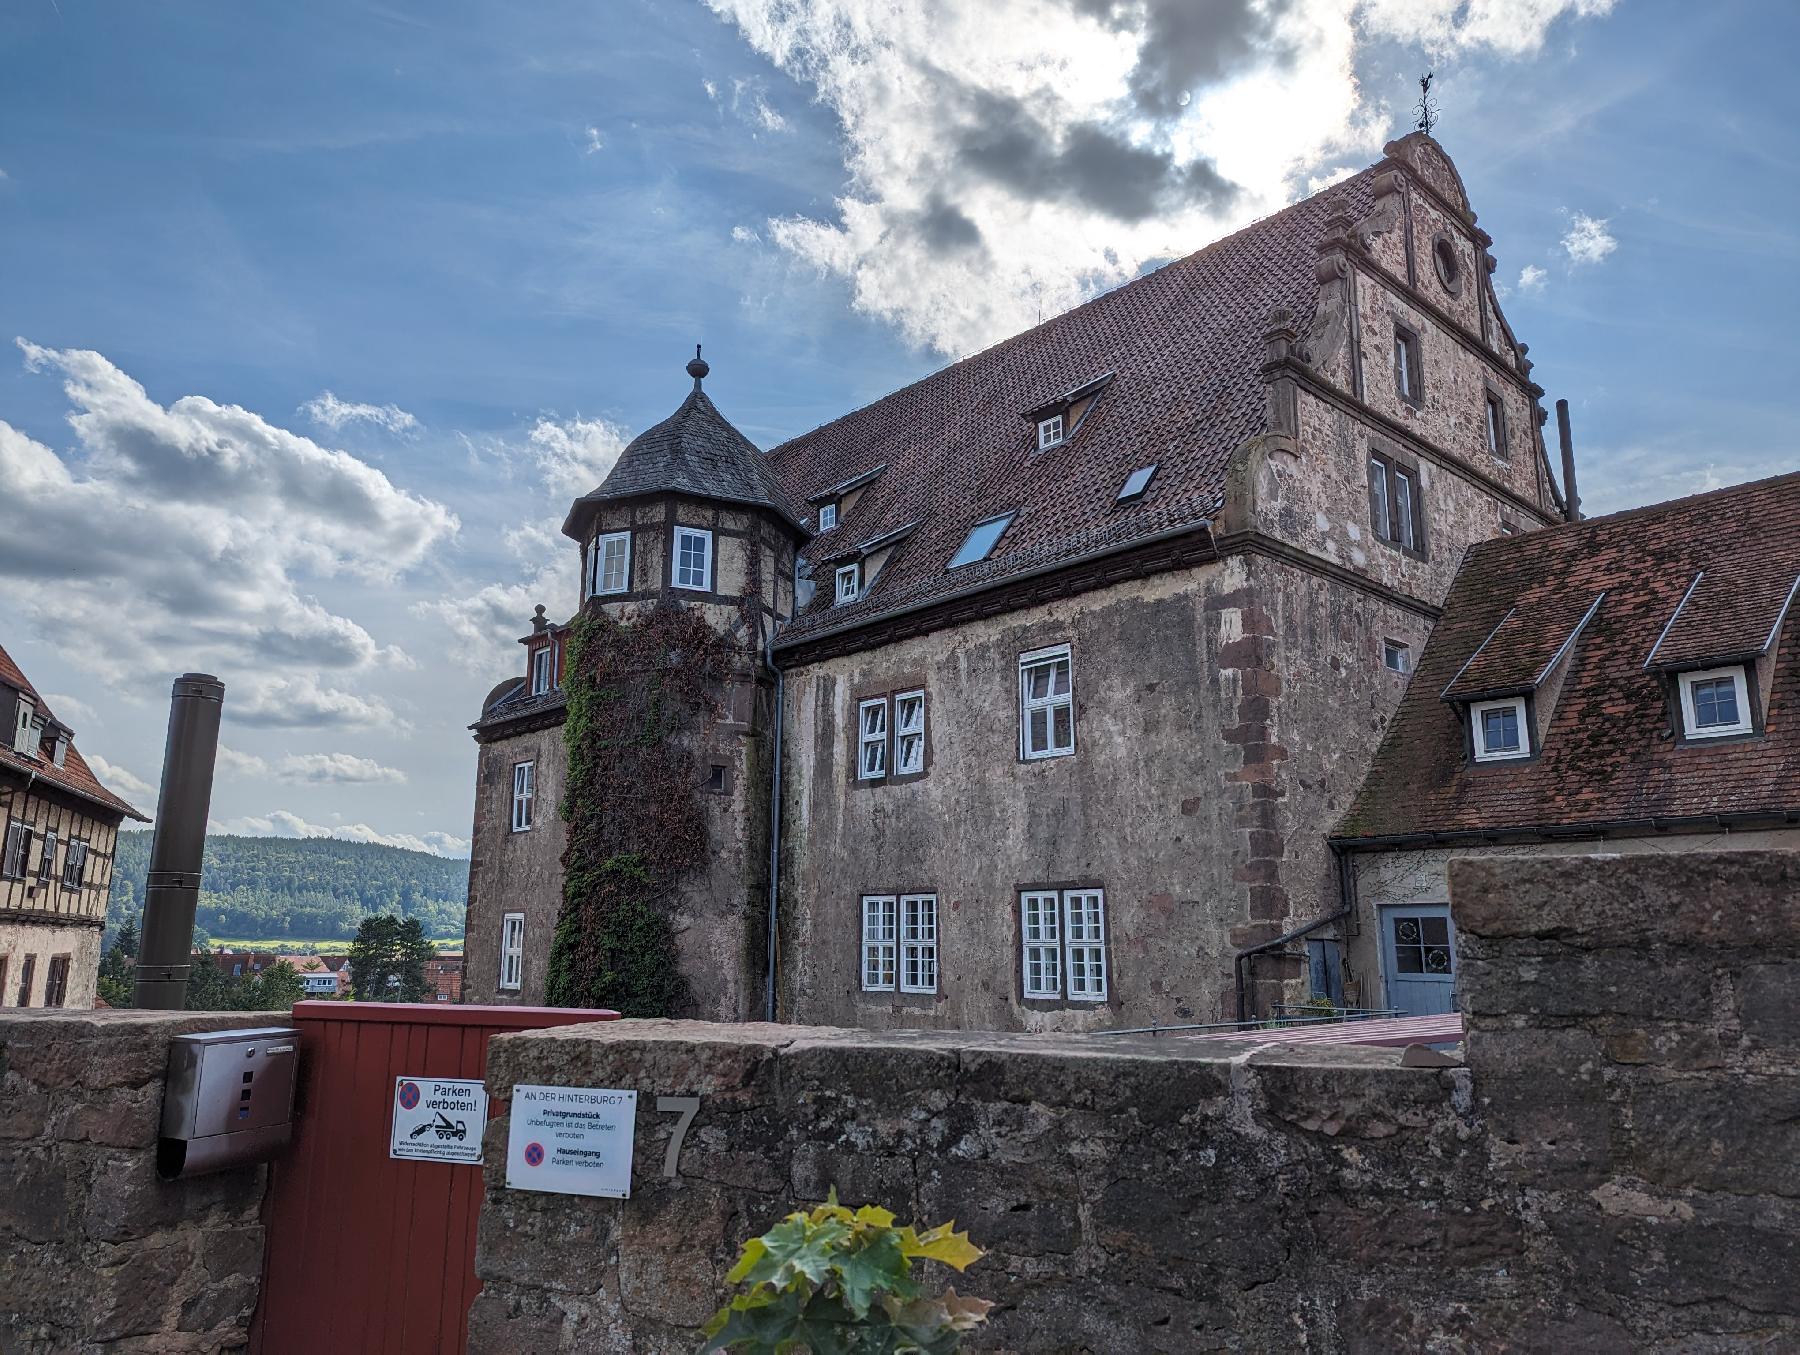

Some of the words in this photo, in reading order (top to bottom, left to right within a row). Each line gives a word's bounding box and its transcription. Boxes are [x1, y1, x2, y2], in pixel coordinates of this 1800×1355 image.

[433, 1084, 471, 1098] Parken
[524, 1091, 537, 1101] AN
[539, 1092, 556, 1102] DER
[558, 1093, 616, 1105] HINTERBURG
[617, 1096, 623, 1105] 7
[425, 1098, 477, 1112] verboten!
[542, 1108, 601, 1120] Privatgrundstück
[526, 1118, 565, 1129] Unbefugten
[574, 1121, 586, 1129] das
[587, 1121, 616, 1131] Betreten
[555, 1131, 585, 1140] verboten
[656, 1096, 700, 1177] 7
[556, 1147, 601, 1159] Hauseingang
[551, 1157, 574, 1167] Parken
[574, 1159, 604, 1168] verboten
